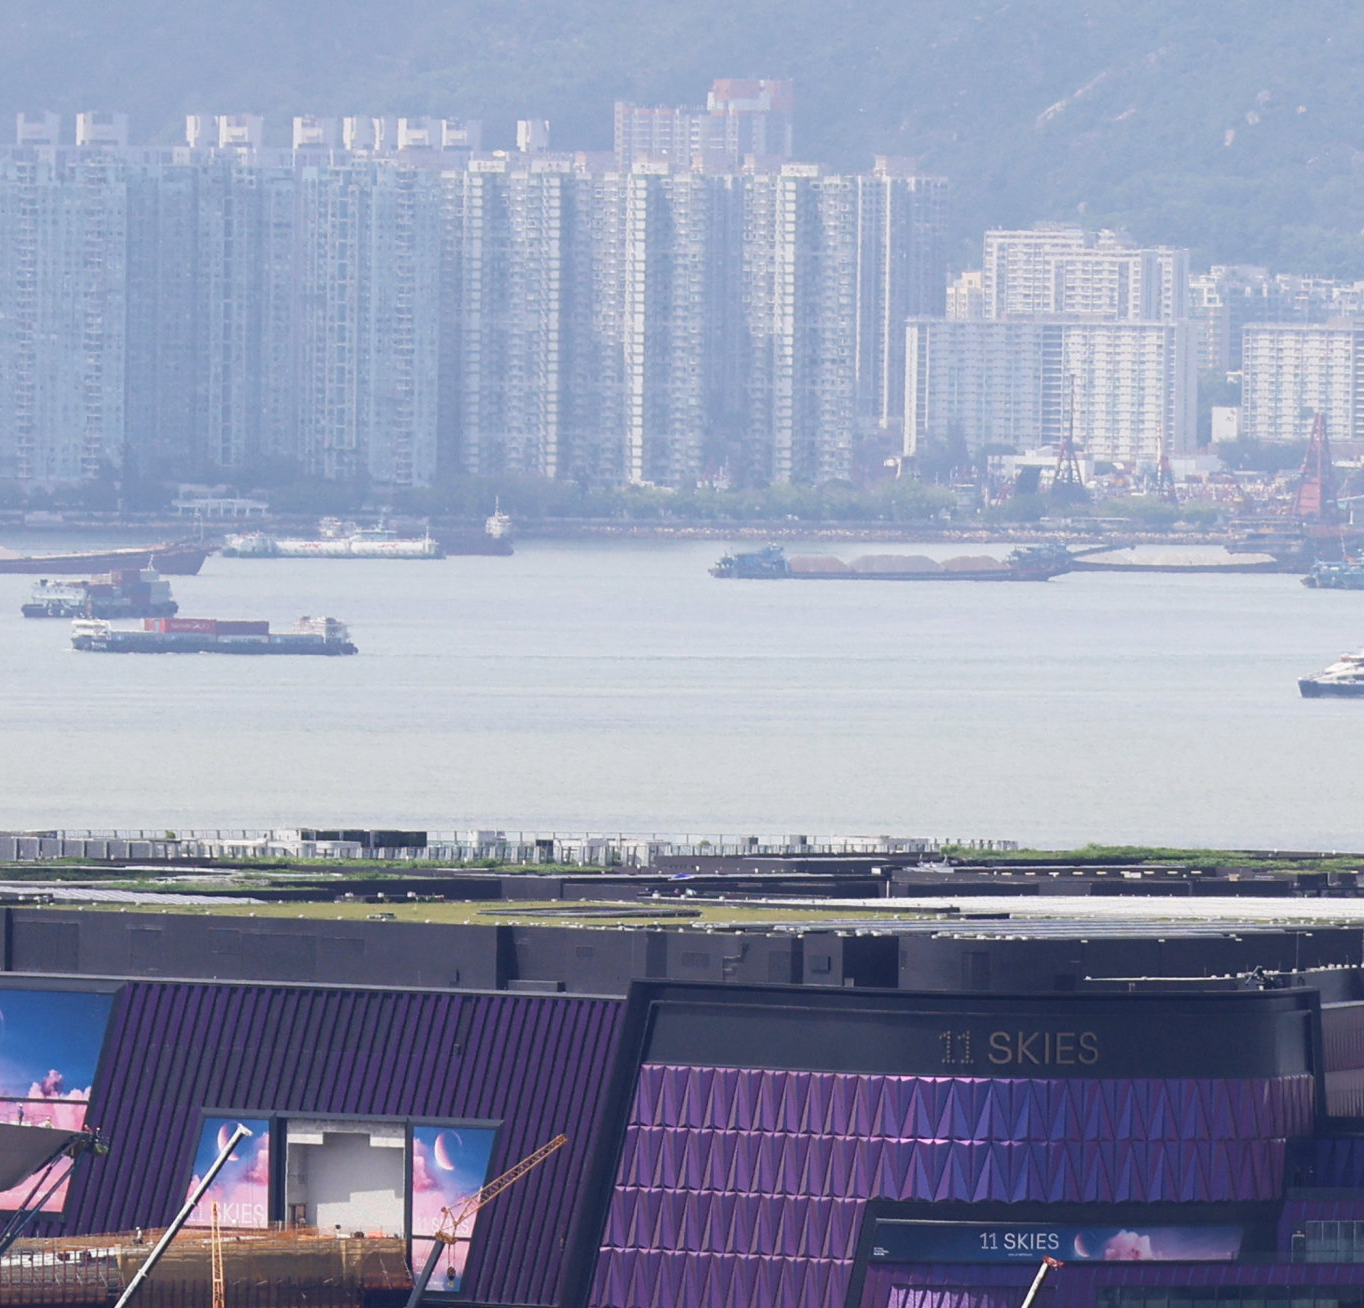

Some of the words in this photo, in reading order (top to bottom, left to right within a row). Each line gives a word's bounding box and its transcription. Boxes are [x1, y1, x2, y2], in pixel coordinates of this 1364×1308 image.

[939, 1030, 975, 1064] 11
[988, 1031, 1099, 1065] SKIES
[979, 1232, 998, 1250] 11
[1003, 1233, 1059, 1250] SKIES
